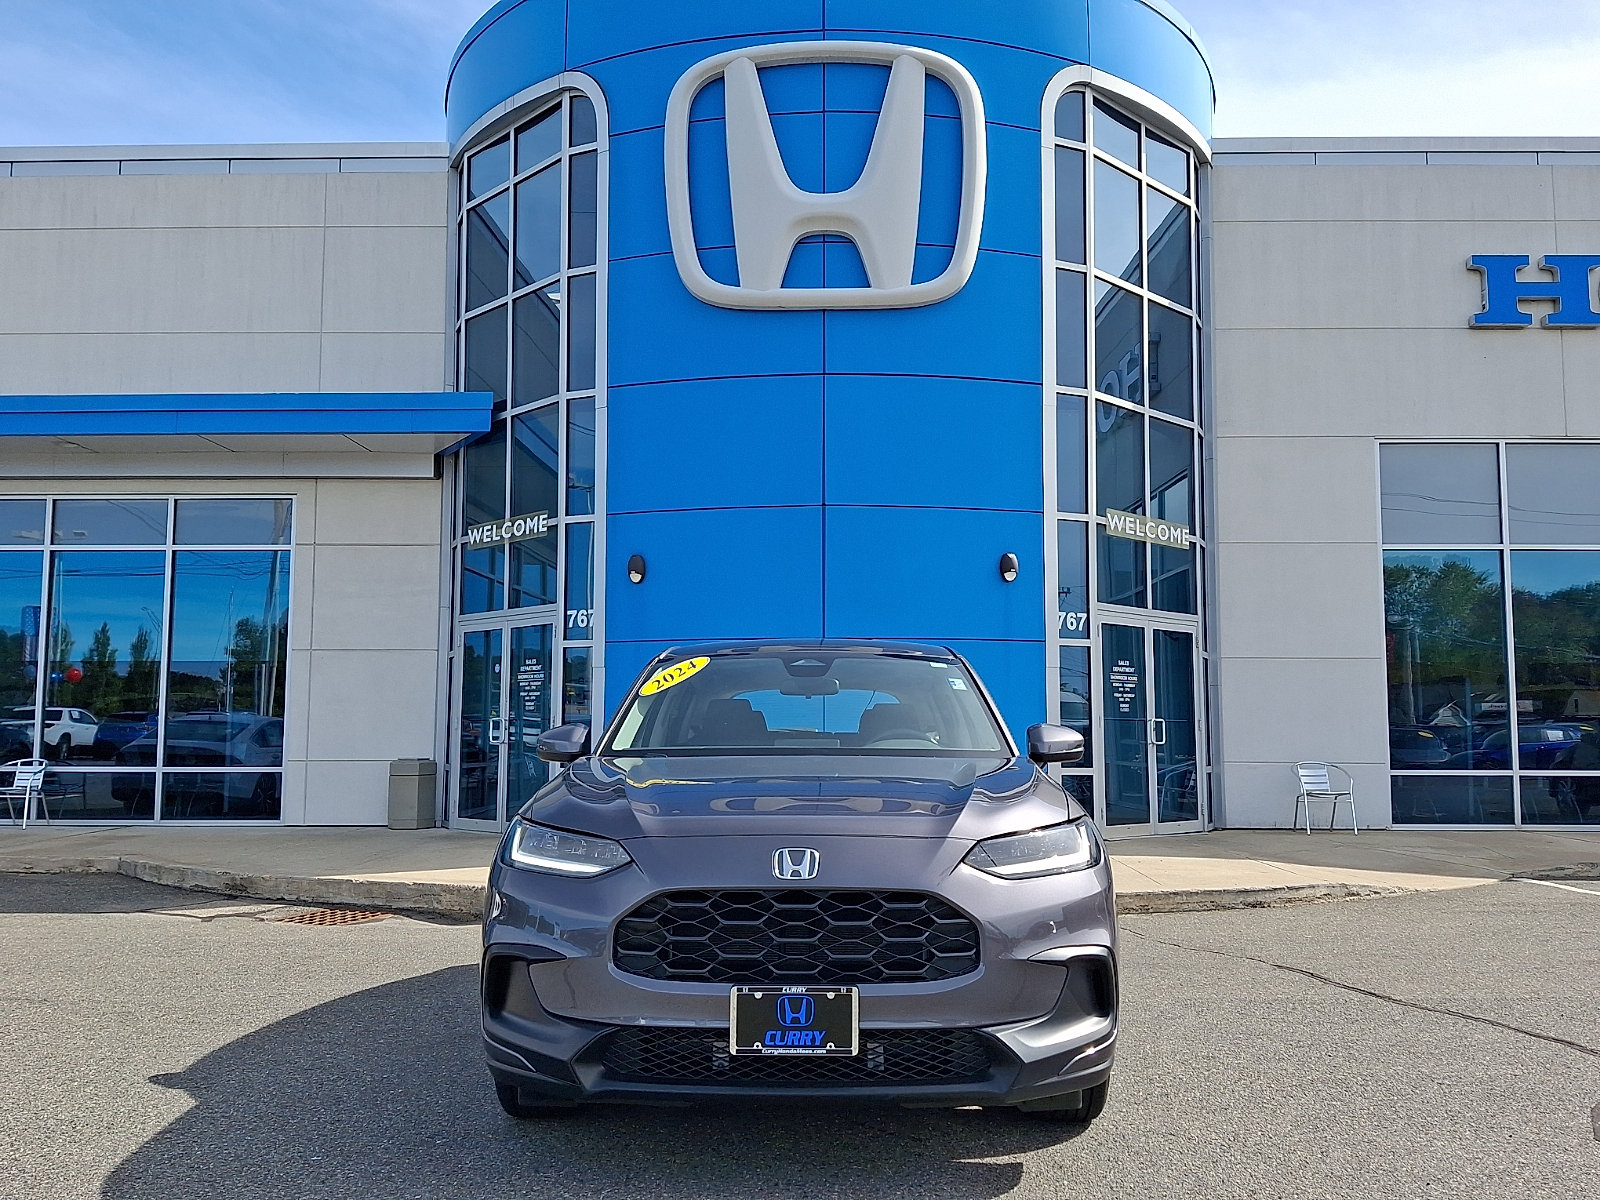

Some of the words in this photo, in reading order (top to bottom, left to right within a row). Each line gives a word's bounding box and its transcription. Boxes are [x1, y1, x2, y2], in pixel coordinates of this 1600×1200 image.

[1466, 253, 1600, 330] H
[468, 514, 548, 545] WELCOME
[1107, 512, 1190, 546] WELCOME
[567, 609, 595, 628] 767
[1058, 612, 1087, 631] 767
[651, 660, 697, 690] 2024
[764, 1030, 827, 1046] CURRY
